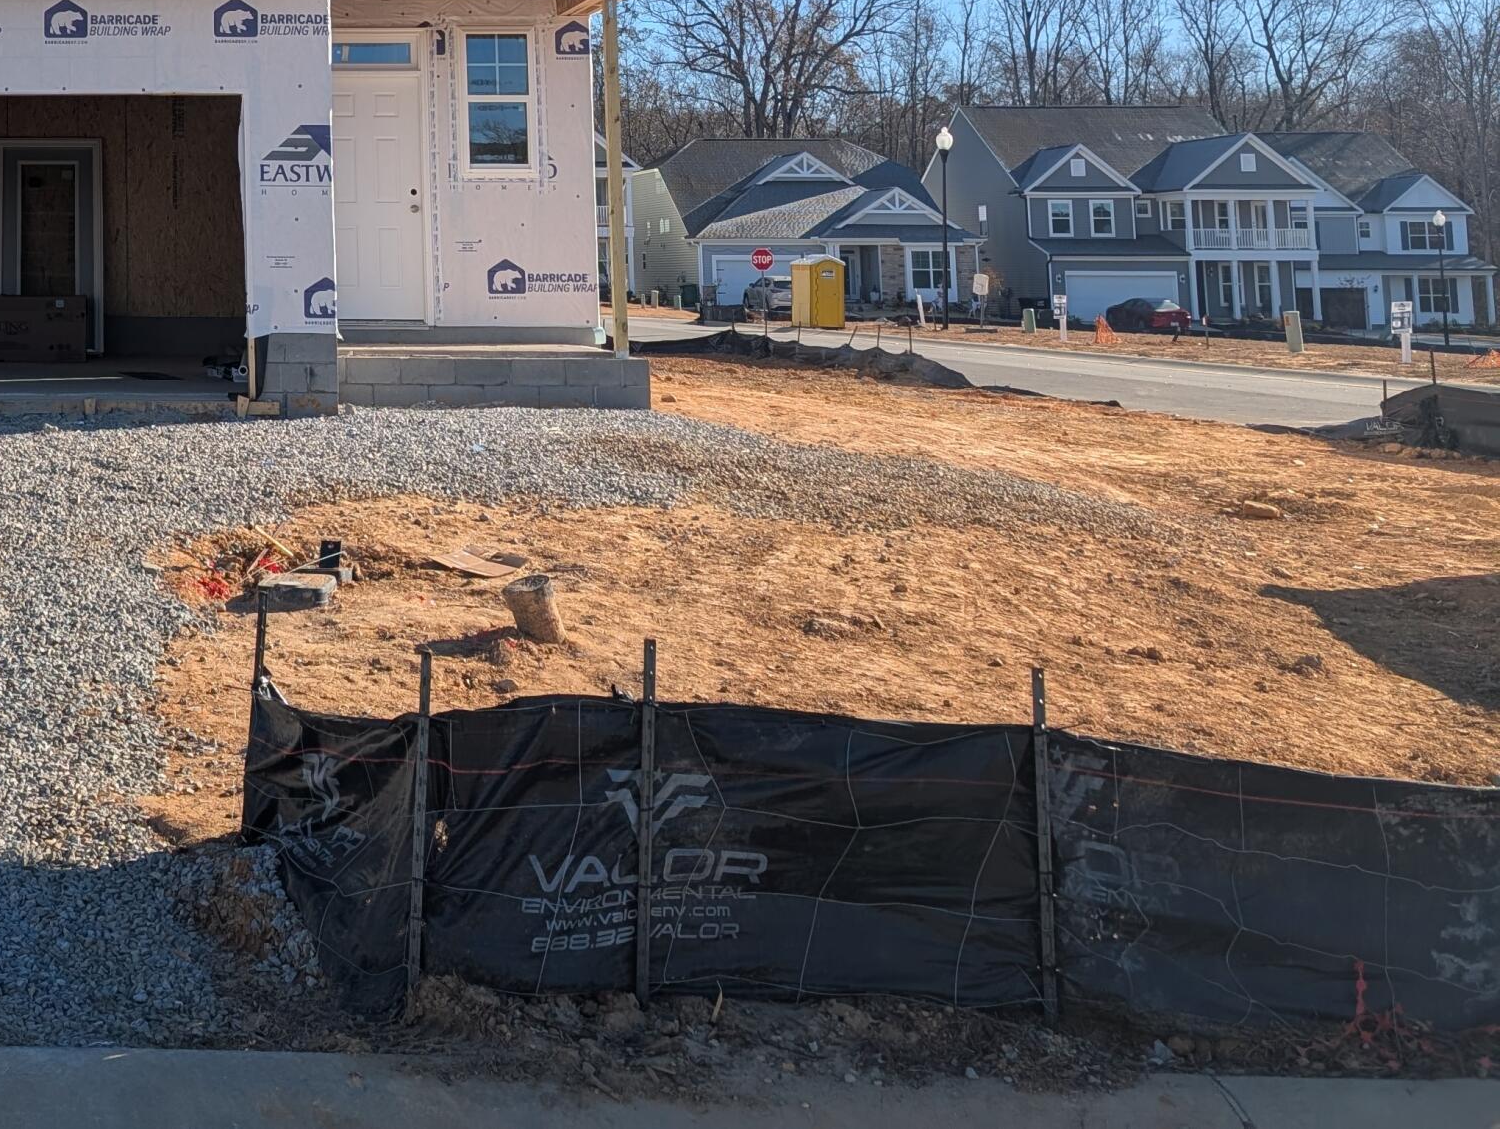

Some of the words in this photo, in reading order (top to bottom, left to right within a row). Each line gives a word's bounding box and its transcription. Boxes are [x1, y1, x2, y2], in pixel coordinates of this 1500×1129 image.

[90, 15, 160, 26] BARRICADE
[260, 14, 328, 25] BARRICADE
[89, 25, 138, 37] BUILDING
[140, 25, 171, 36] WRAP
[260, 24, 308, 36] BUILDING
[752, 255, 772, 264] STOP
[528, 274, 590, 284] BARRICADE
[527, 282, 571, 294] BUILDING
[529, 847, 769, 894] VALOR
[521, 885, 757, 915] ENVIRONENTAL
[545, 904, 731, 932] www.valoenv.com
